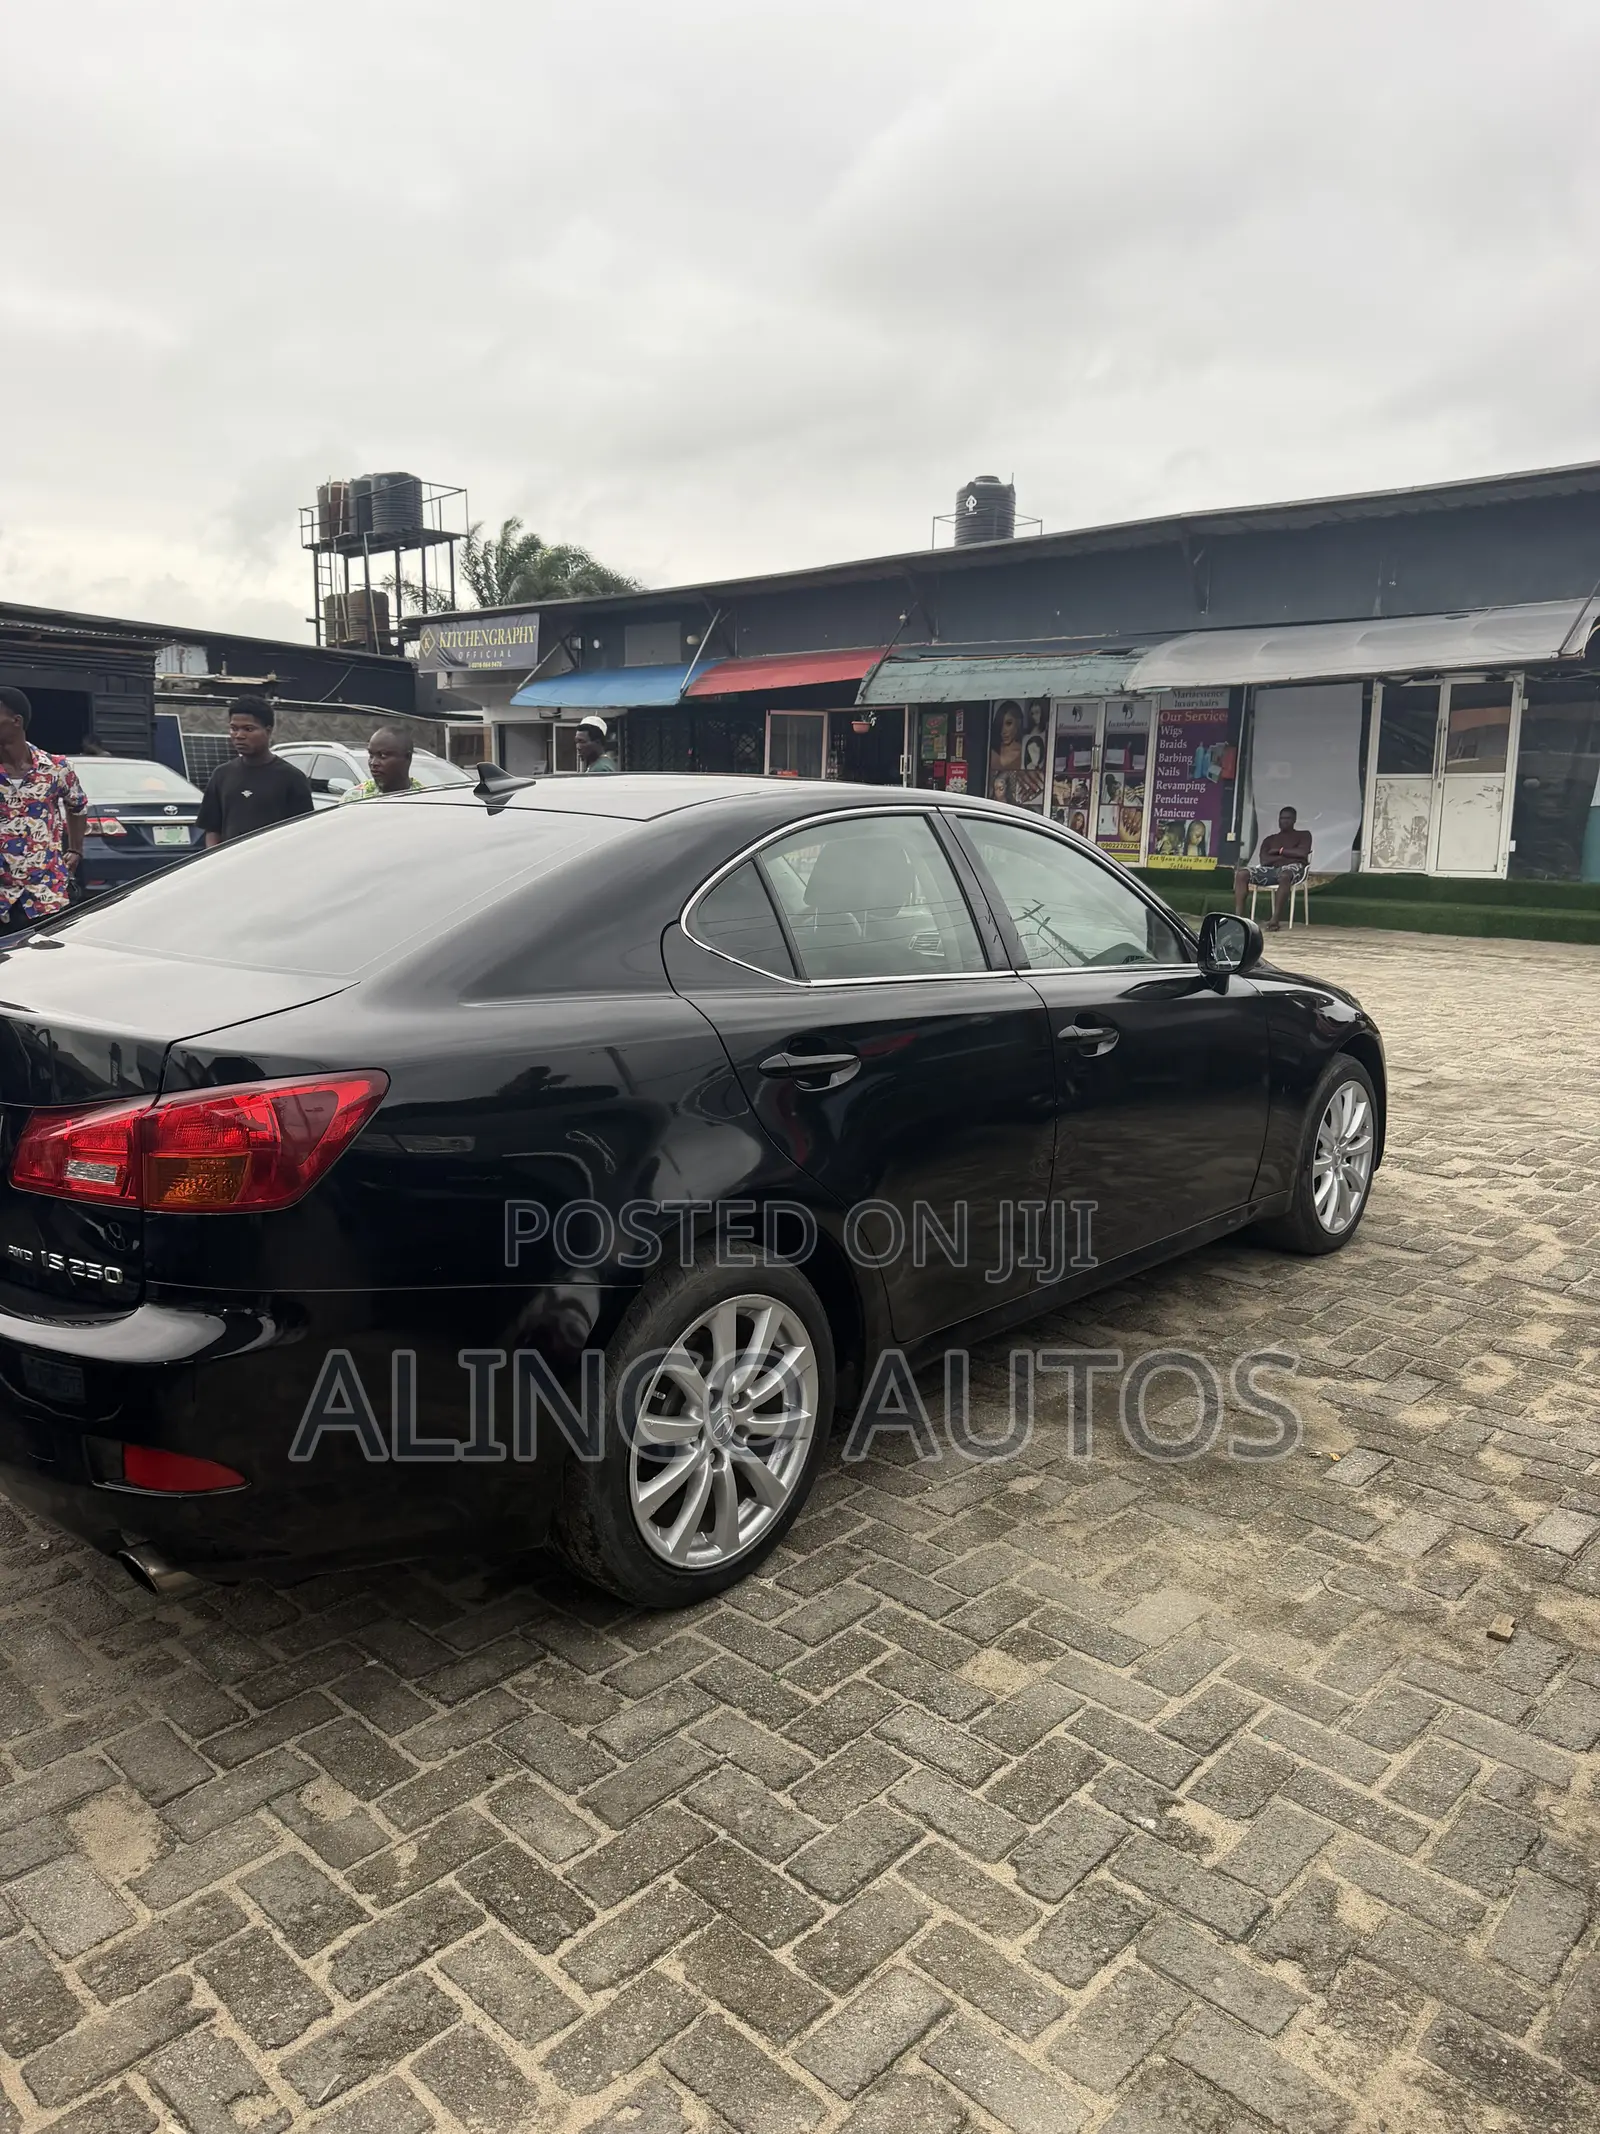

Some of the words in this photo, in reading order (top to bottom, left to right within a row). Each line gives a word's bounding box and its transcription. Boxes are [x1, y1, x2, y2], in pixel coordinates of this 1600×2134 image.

[439, 626, 536, 648] KITCHENGRAPHY
[424, 638, 431, 649] K
[458, 649, 512, 660] OFFICIAL
[1160, 711, 1182, 721] Our
[1160, 725, 1183, 738] Wigs
[1160, 739, 1188, 749] Braids
[1158, 753, 1193, 766] Barbing
[1157, 766, 1180, 776] Nails
[1156, 780, 1206, 793] Revamping
[1155, 794, 1199, 804] Pendicure
[1153, 807, 1196, 818] Manicure
[40, 1250, 64, 1271] IS
[68, 1258, 123, 1285] 250
